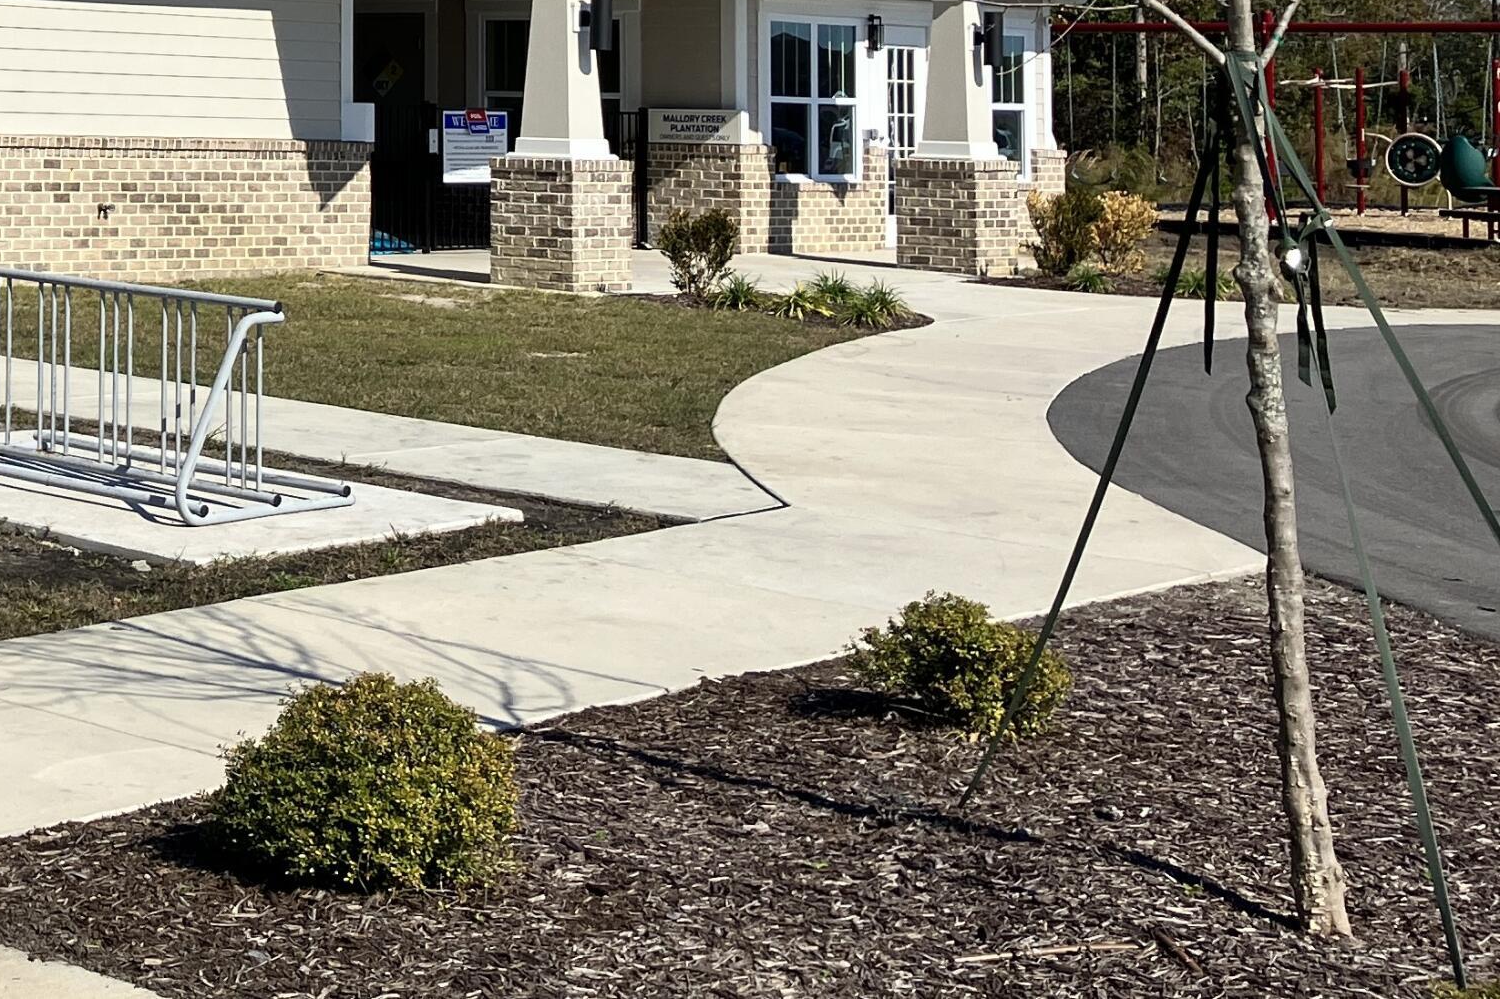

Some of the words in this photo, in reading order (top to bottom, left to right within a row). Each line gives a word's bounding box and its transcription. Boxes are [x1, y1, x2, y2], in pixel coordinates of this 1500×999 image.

[662, 114, 700, 123] MALLORY
[701, 115, 727, 123] CREEK
[670, 124, 720, 133] PLANTATION
